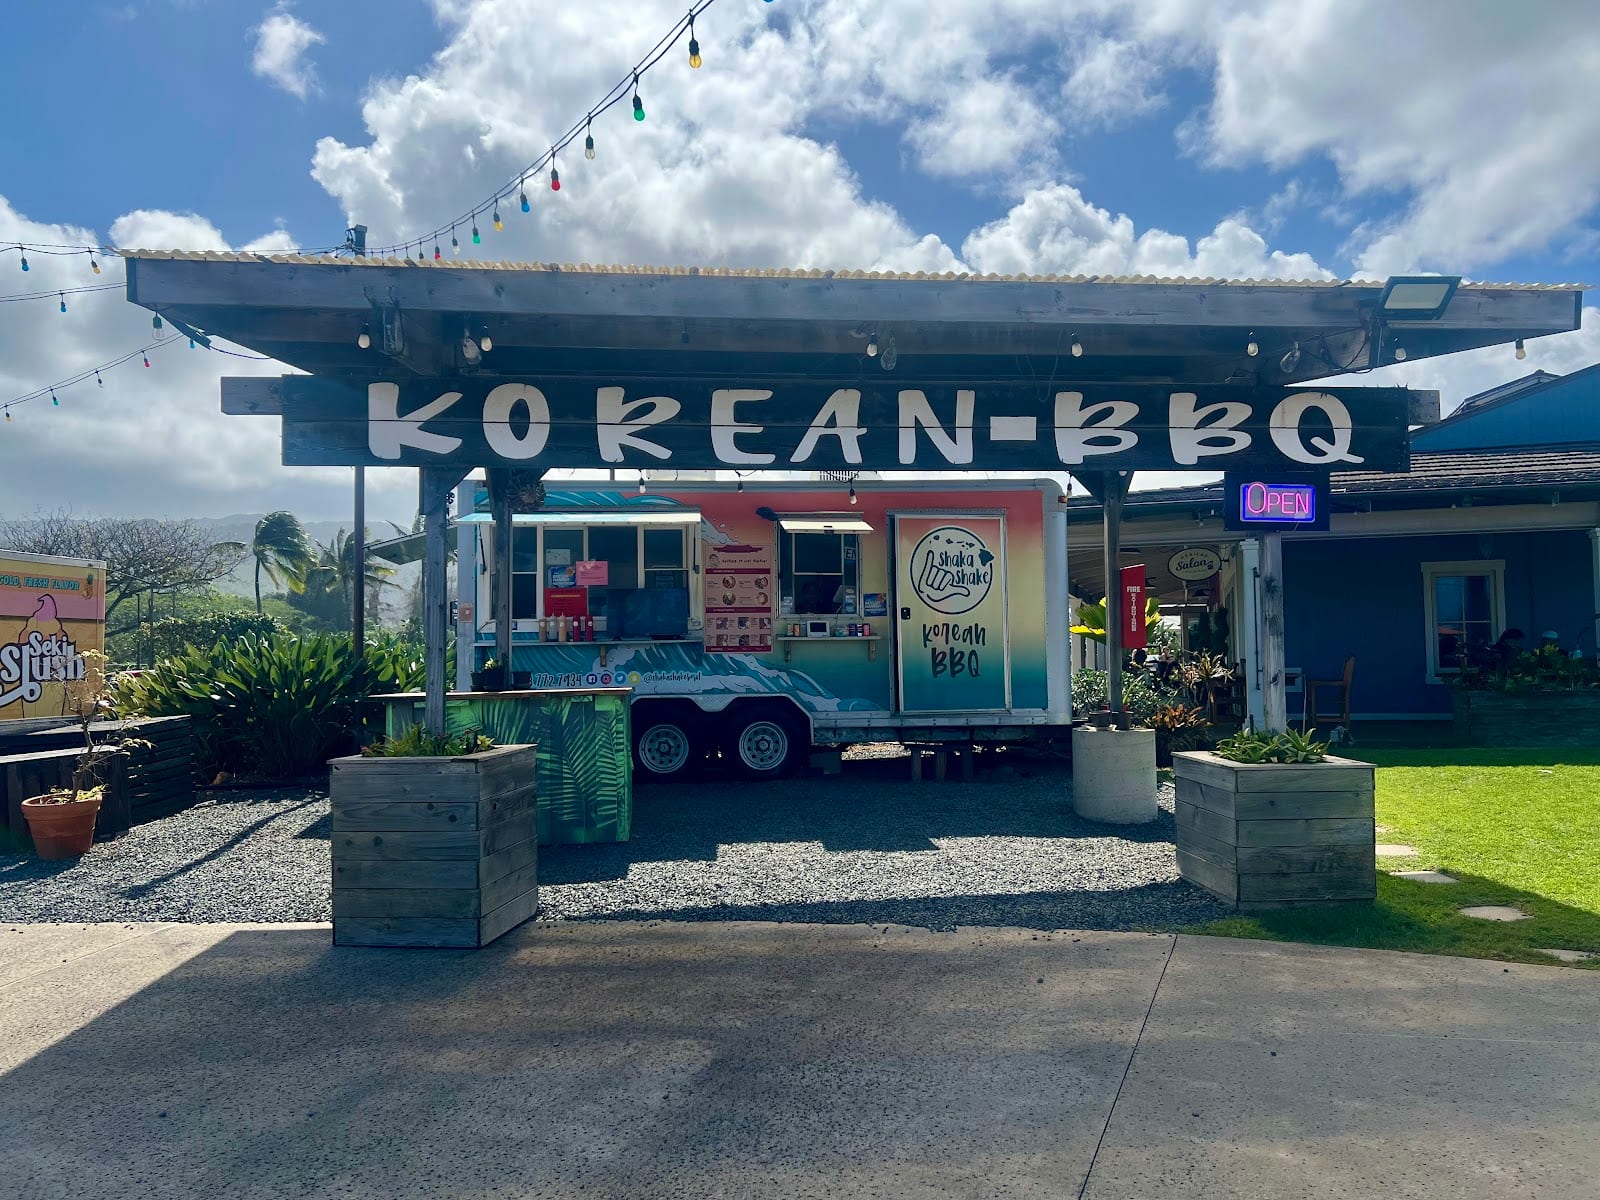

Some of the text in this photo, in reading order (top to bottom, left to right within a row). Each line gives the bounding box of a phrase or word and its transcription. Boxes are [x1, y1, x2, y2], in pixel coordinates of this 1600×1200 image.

[367, 381, 1366, 466] KOREAN-BBQ
[1175, 557, 1207, 572] Salon
[24, 576, 49, 588] FRESH
[51, 579, 80, 591] FLAVOR
[1126, 585, 1141, 593] FIRE
[28, 631, 68, 656] Seki
[931, 647, 981, 679] BBQ
